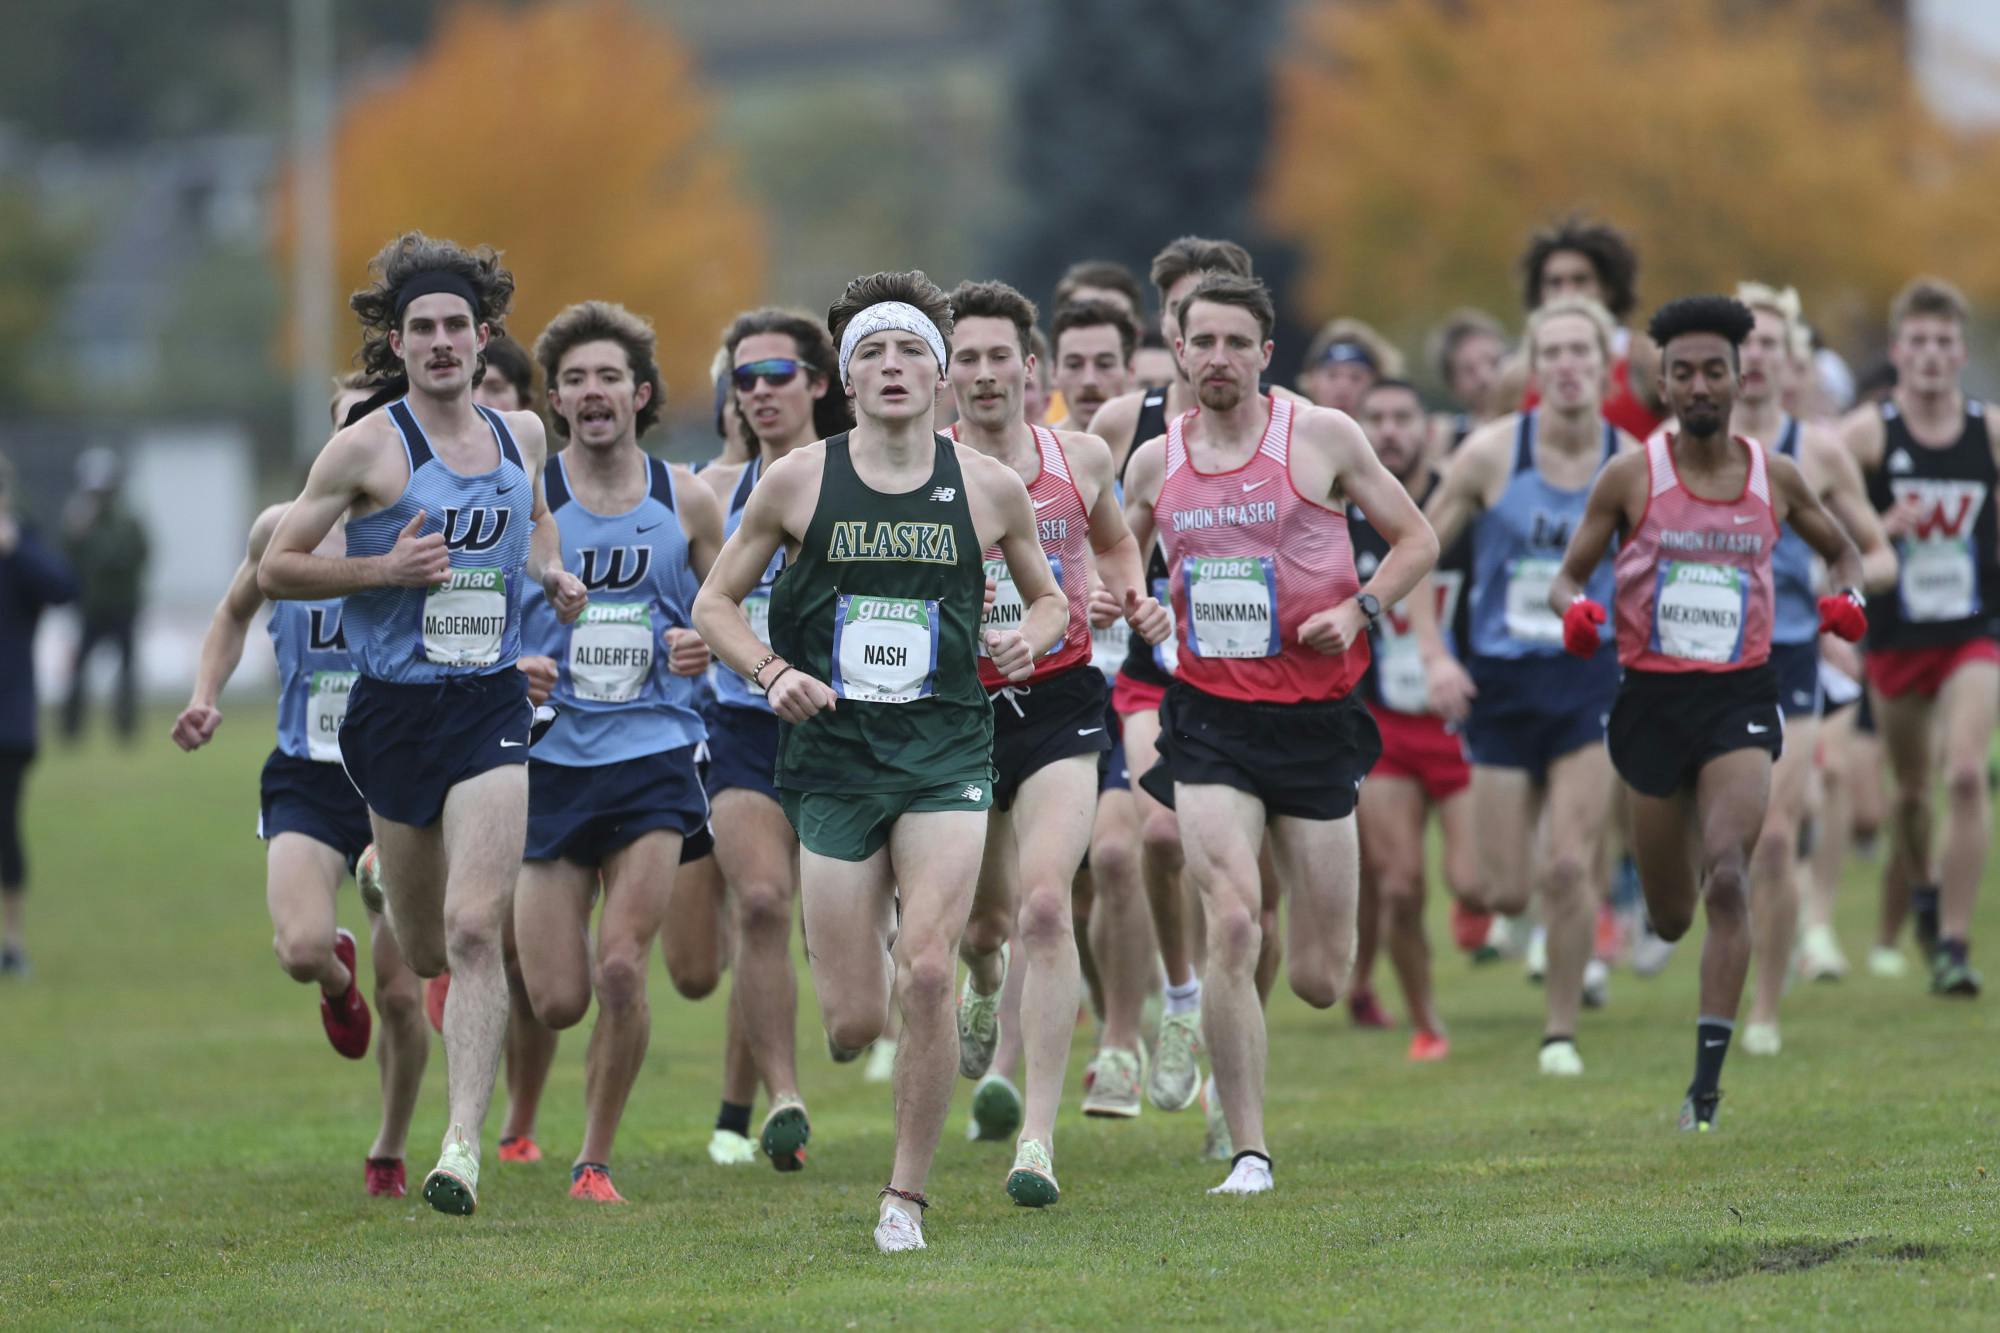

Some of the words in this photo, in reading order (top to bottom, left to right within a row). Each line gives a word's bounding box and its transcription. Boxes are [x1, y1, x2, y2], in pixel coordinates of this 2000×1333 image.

[1172, 507, 1213, 532] SIMON
[1218, 501, 1276, 527] FRASER
[442, 507, 512, 553] W
[828, 521, 958, 565] ALASKA
[1660, 529, 1704, 550] SIMON
[1707, 531, 1763, 555] FRASER
[576, 545, 652, 593] W
[1199, 560, 1253, 581] gnac
[1676, 564, 1732, 585] gnac
[440, 571, 497, 593] gnac
[586, 606, 643, 624] gnac
[857, 599, 920, 621] gnac
[1194, 602, 1268, 622] BRINKMAN
[1660, 603, 1738, 628] MEKONNEN
[425, 616, 504, 636] McDERMOTT
[576, 646, 649, 667] ALDERFER
[864, 645, 907, 667] NASH
